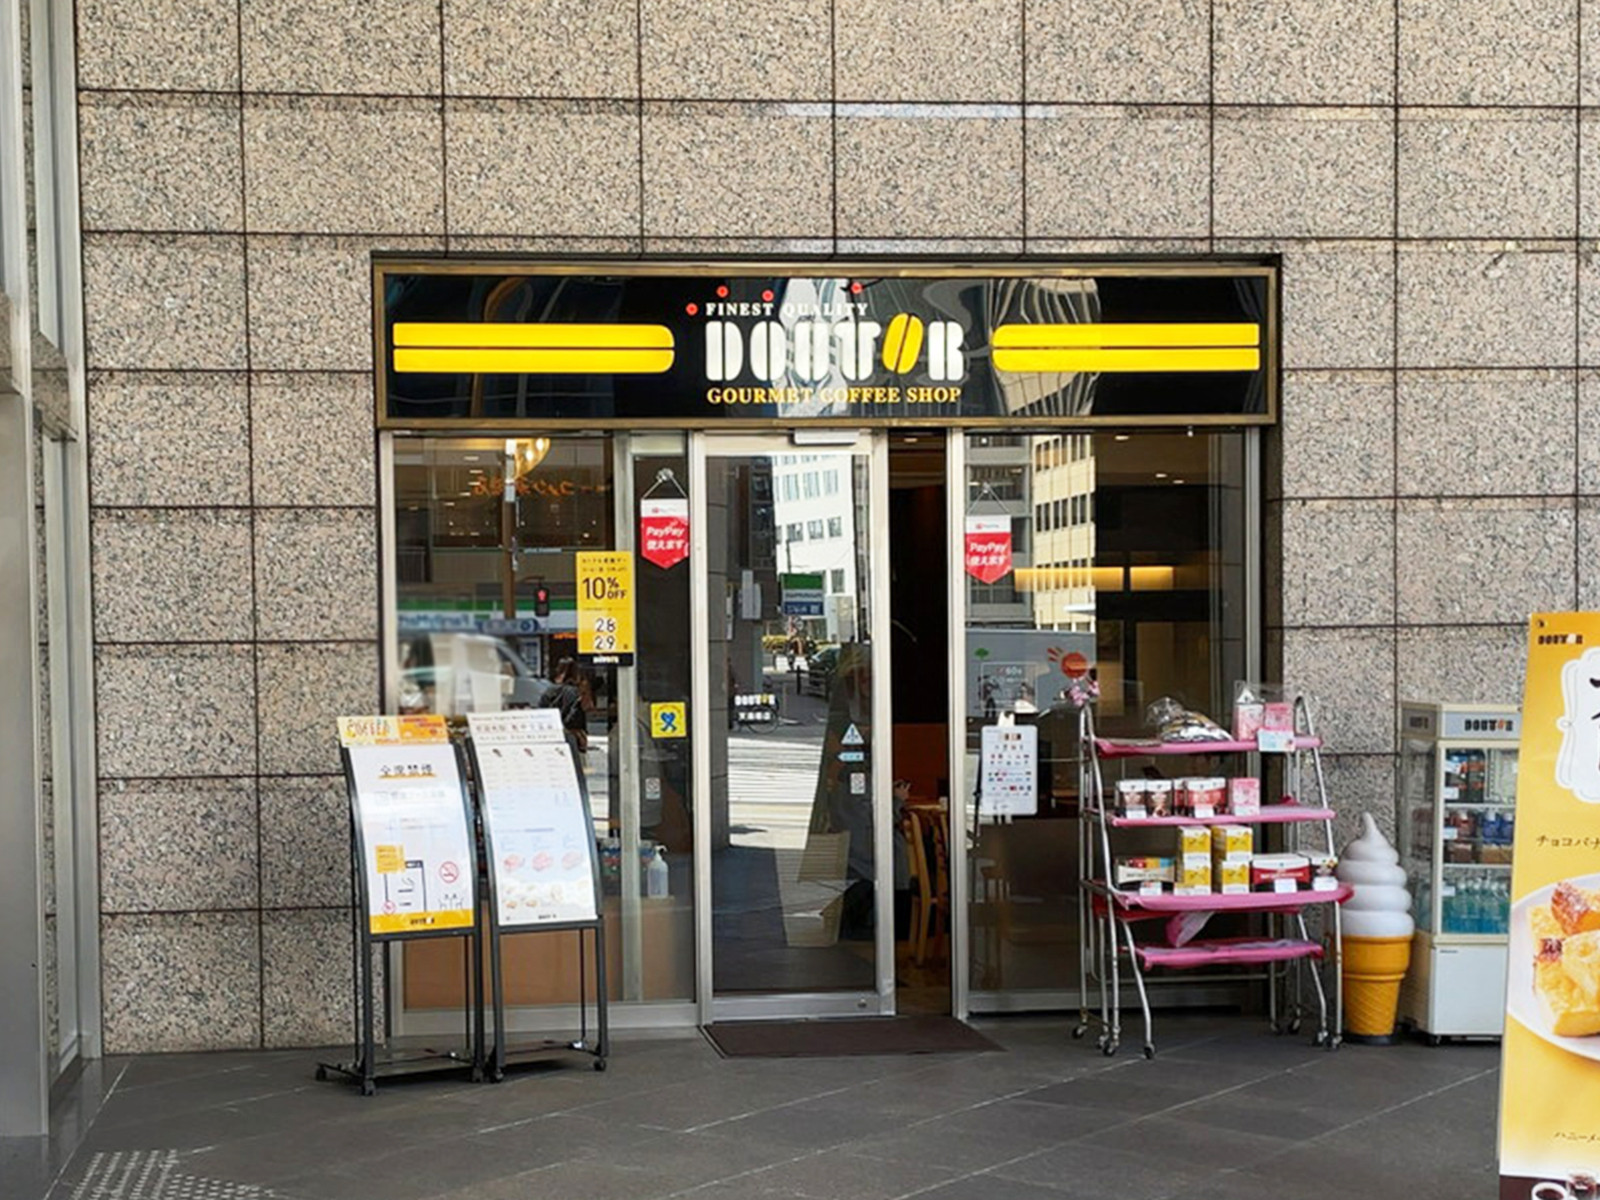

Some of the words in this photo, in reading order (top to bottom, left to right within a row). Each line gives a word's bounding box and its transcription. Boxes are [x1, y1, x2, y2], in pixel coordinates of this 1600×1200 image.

[705, 302, 775, 317] FINEST
[783, 302, 869, 317] QUALITY
[705, 312, 965, 382] DOUTOR
[706, 387, 815, 404] GOURMET
[820, 387, 902, 404] COFFEE
[906, 387, 962, 403] SHOP
[646, 526, 686, 538] PayPay
[969, 542, 1008, 554] PayPay
[606, 590, 628, 600] OFF
[595, 617, 617, 633] 28
[594, 634, 617, 650] 29
[1464, 719, 1513, 732] DOUTOR
